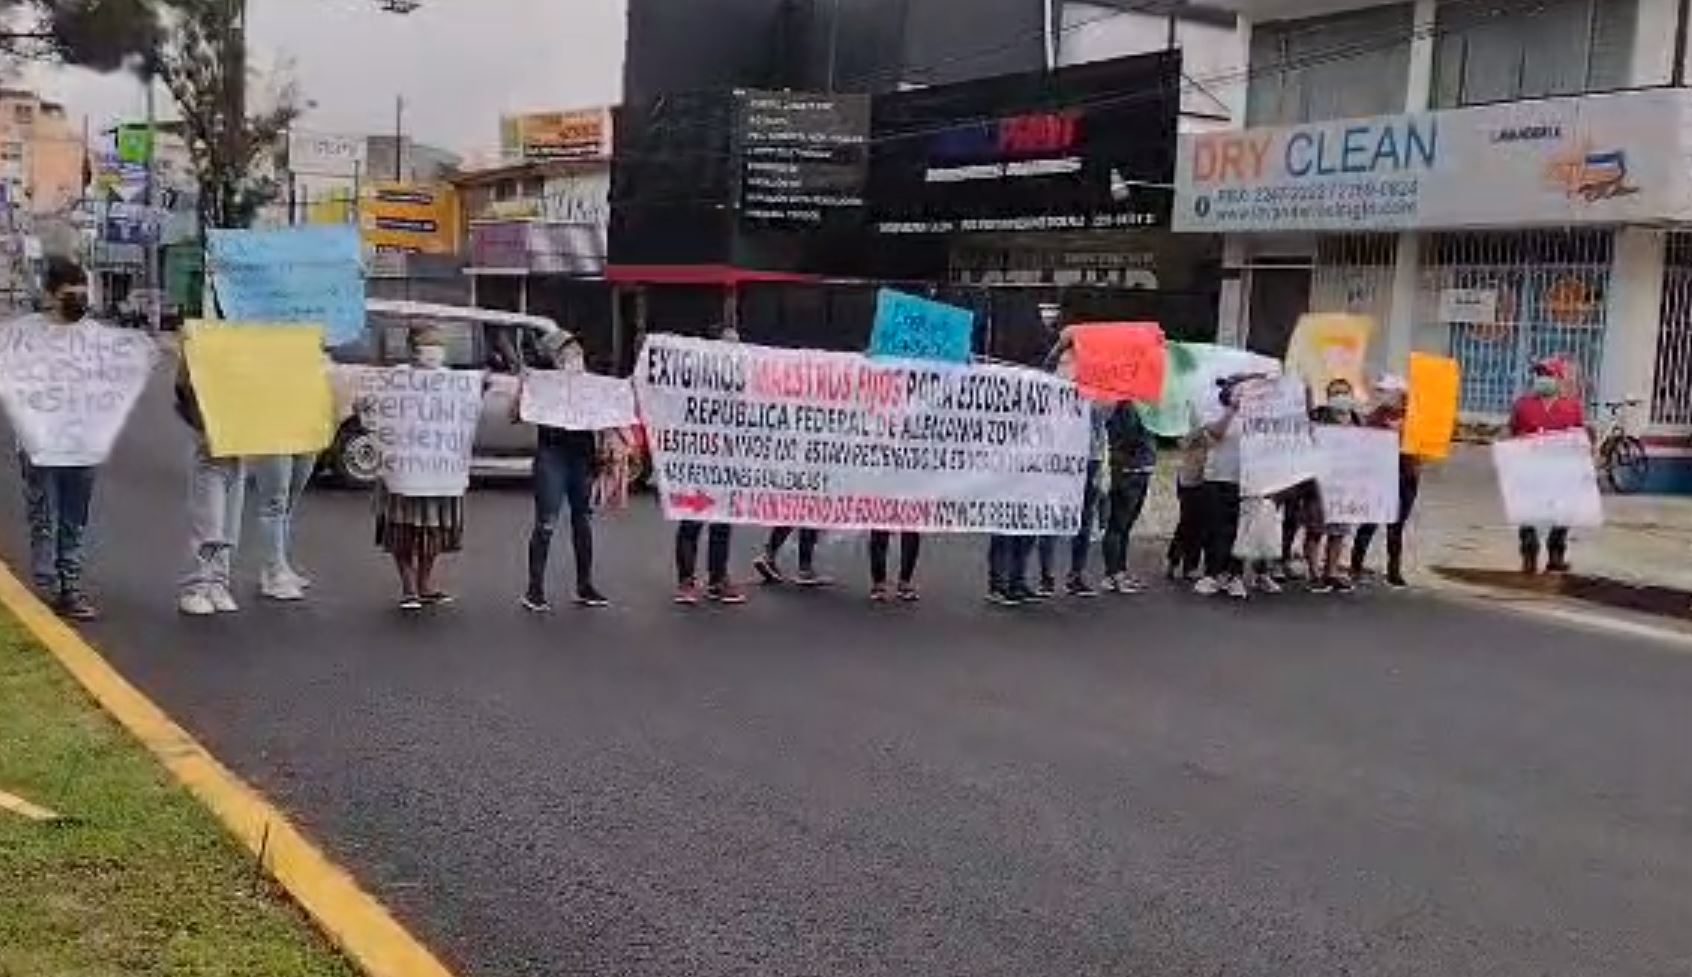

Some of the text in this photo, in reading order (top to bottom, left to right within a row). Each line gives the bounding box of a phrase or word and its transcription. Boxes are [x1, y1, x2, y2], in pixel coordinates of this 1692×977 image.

[1192, 116, 1439, 182] DRY CLEAN
[795, 405, 869, 438] FEDERAL
[875, 411, 896, 438] DE
